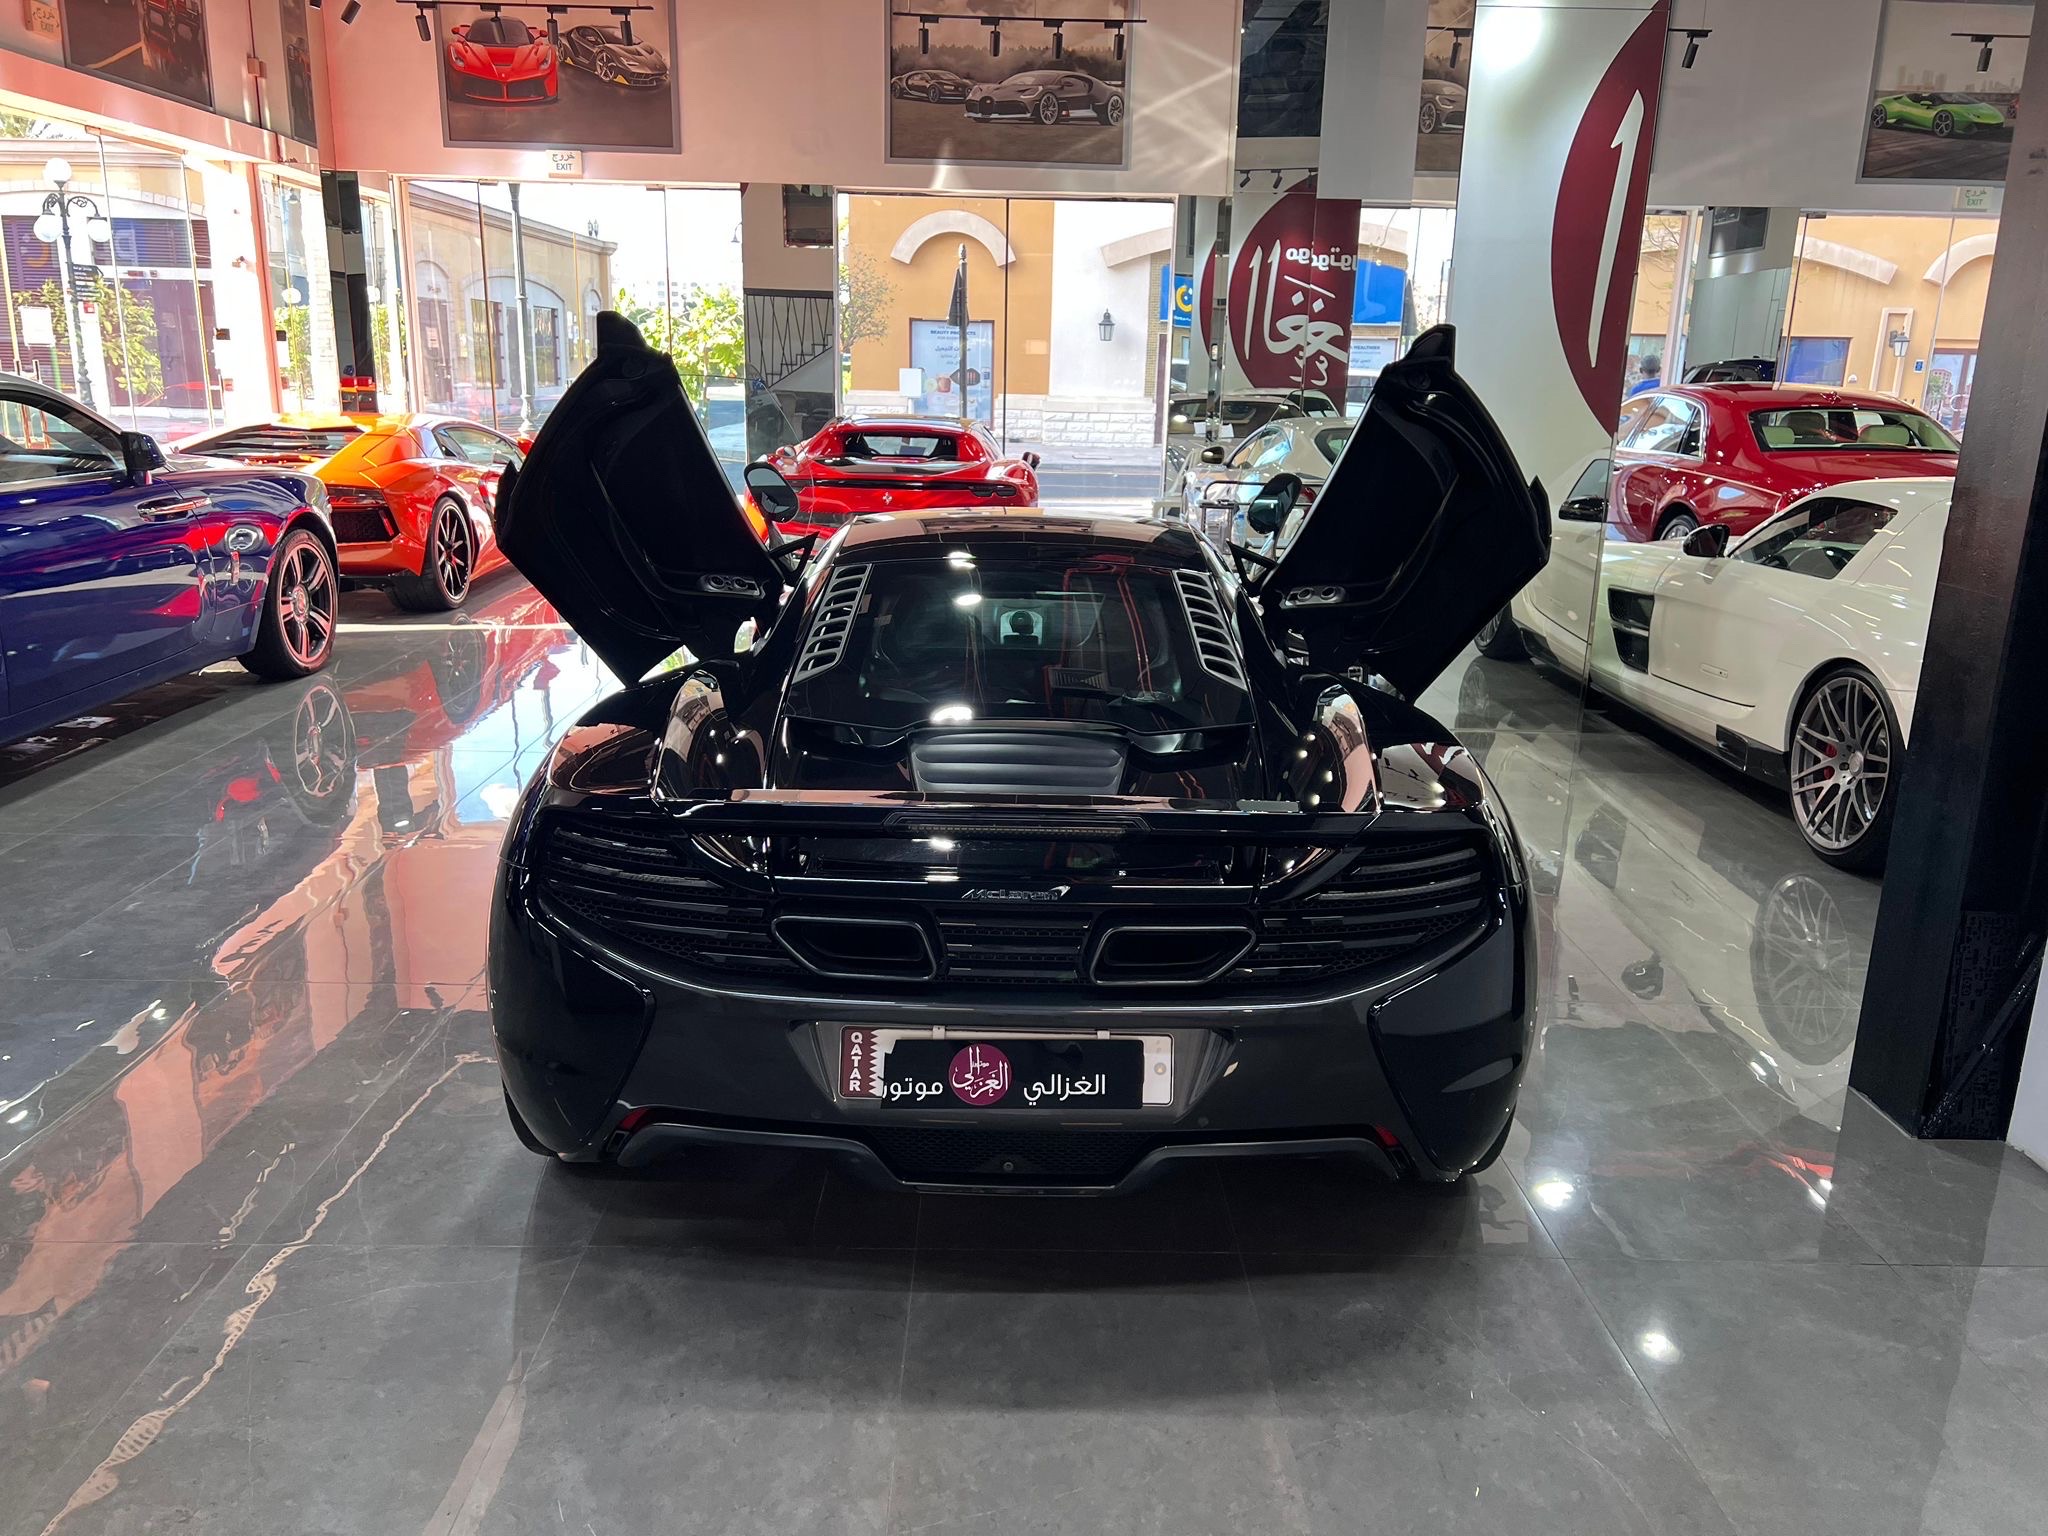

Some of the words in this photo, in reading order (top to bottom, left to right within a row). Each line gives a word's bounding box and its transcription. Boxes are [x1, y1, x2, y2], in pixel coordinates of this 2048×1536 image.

[552, 152, 575, 162] خروج
[556, 163, 573, 171] EXIT
[849, 1031, 863, 1092] QATAR
[1023, 1073, 1106, 1106] الغزالي
